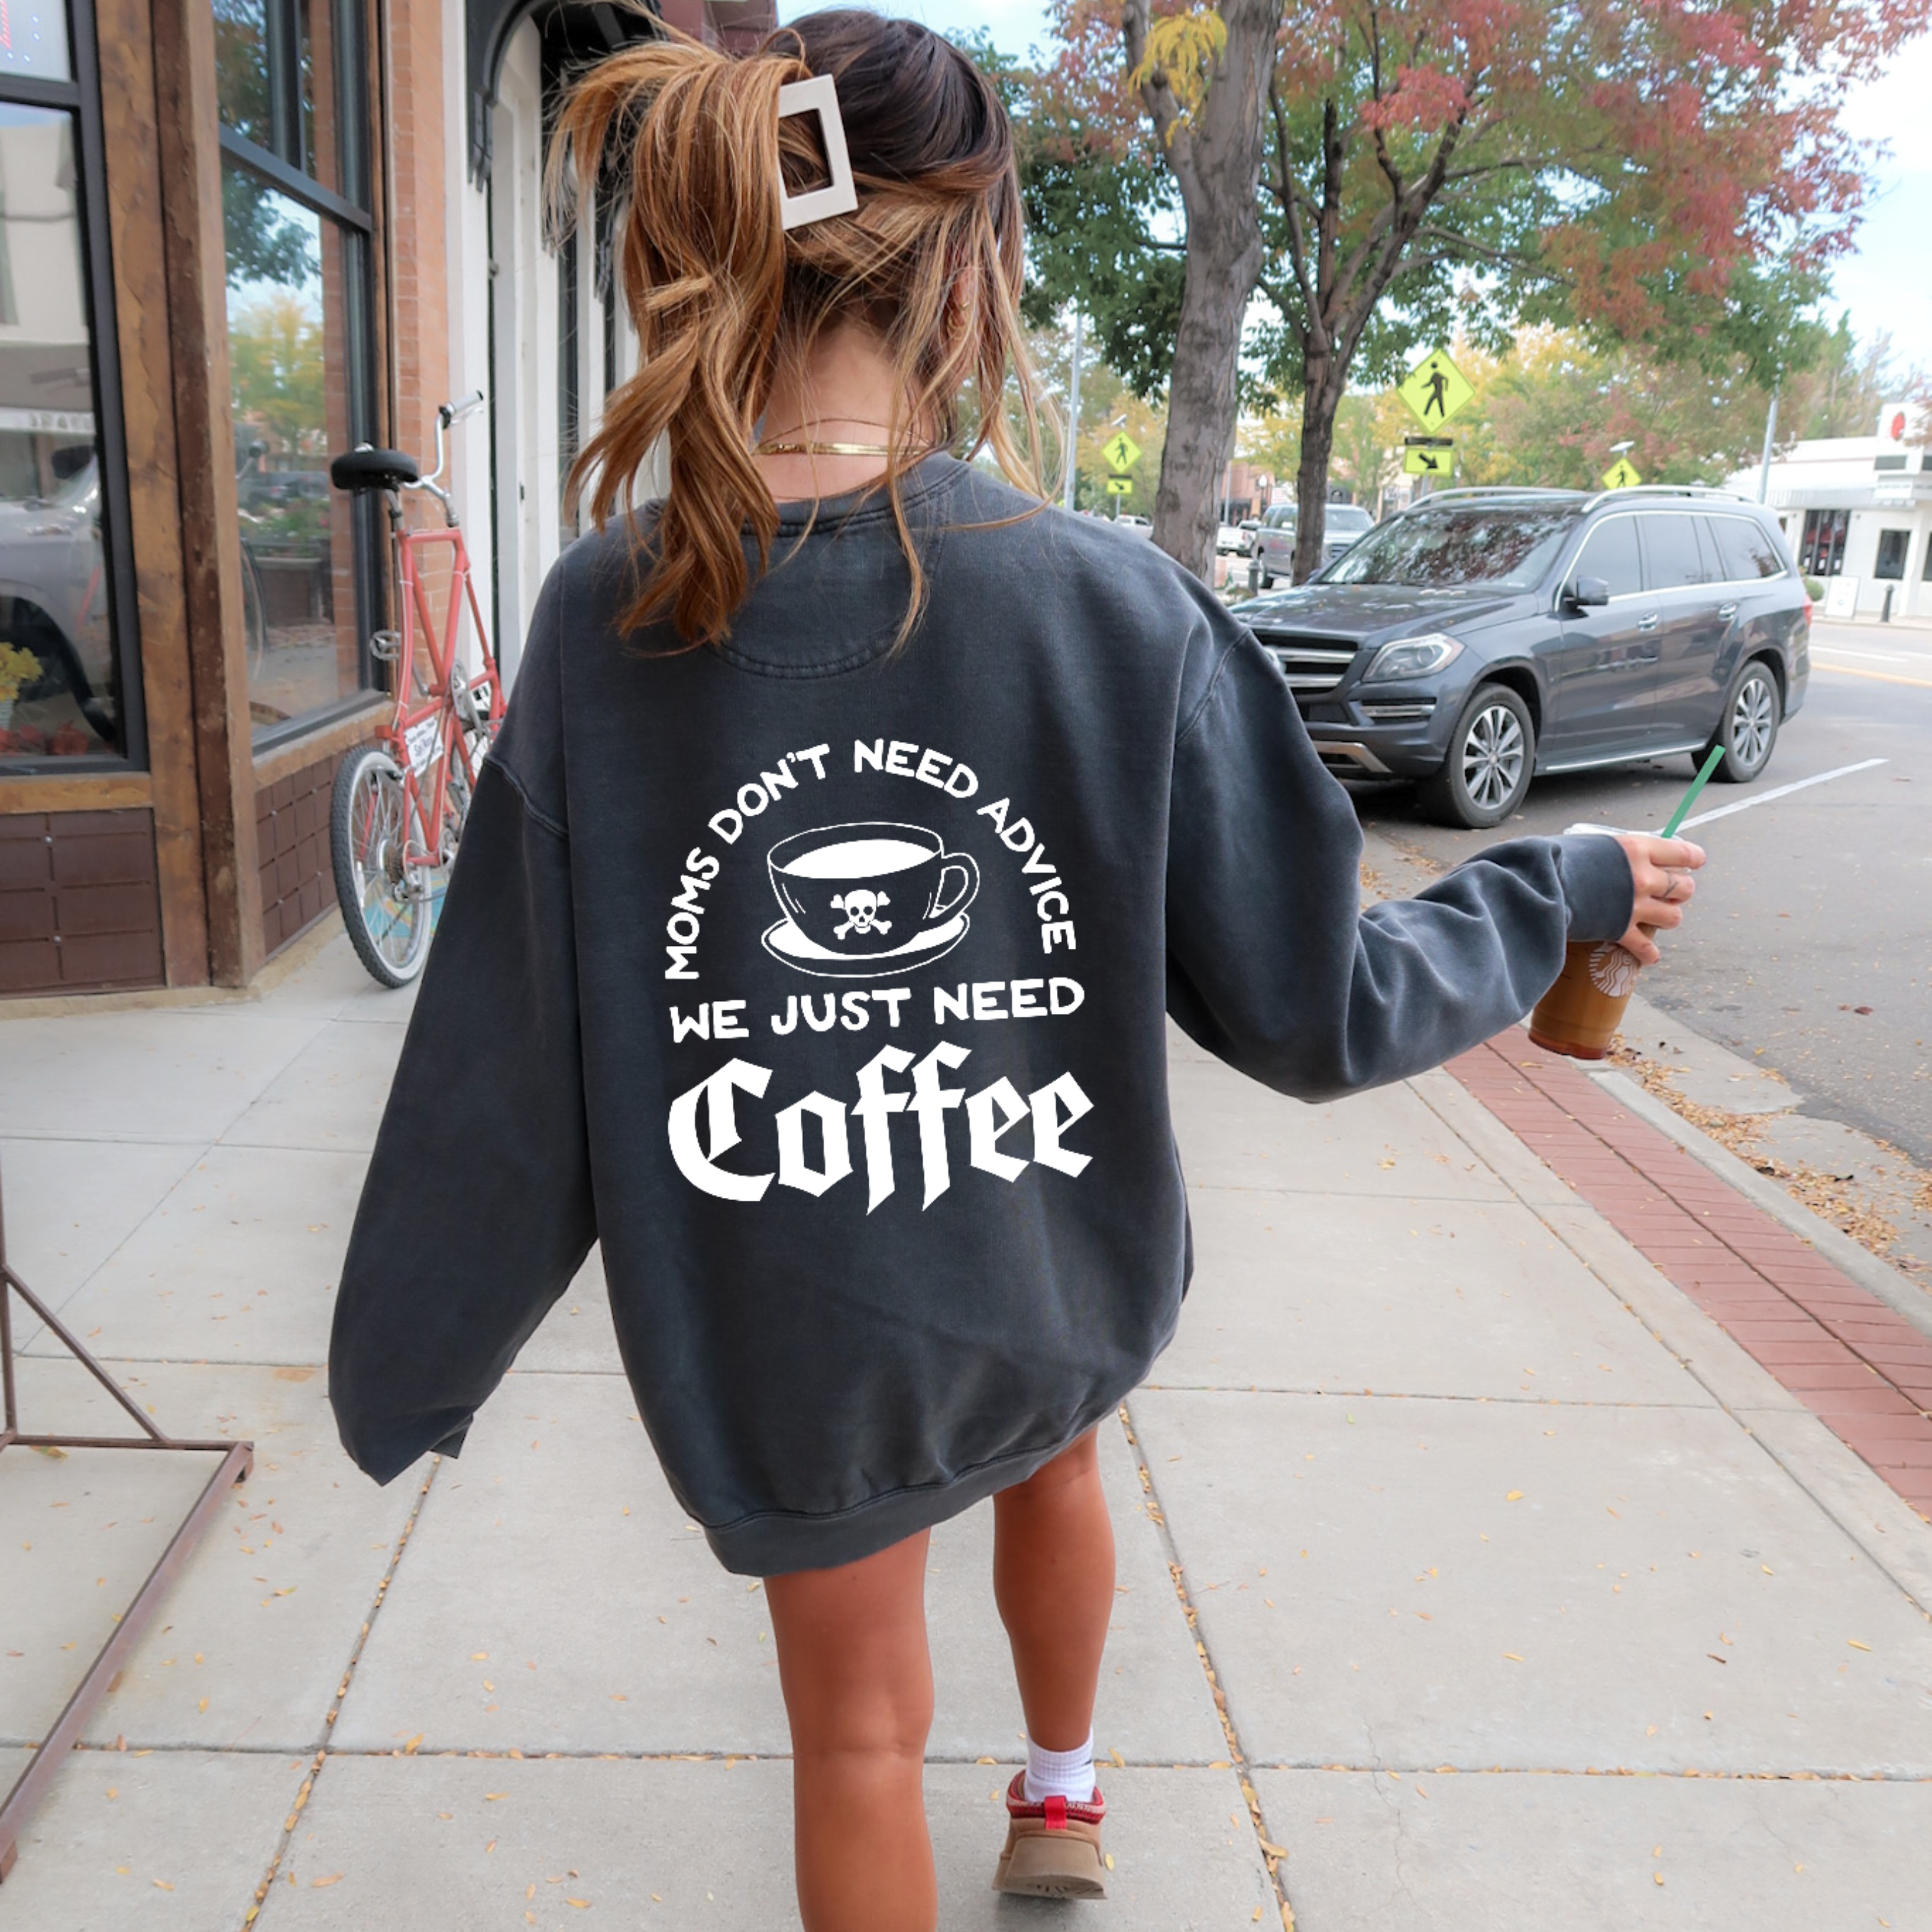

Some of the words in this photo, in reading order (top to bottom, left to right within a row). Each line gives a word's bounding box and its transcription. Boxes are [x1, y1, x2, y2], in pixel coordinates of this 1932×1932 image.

[665, 847, 719, 979] MOMS
[708, 744, 830, 844] DON'T
[854, 738, 978, 798] NEED
[977, 798, 1076, 953] ADVICE
[670, 1000, 749, 1043] WE
[771, 987, 912, 1035] JUST
[934, 977, 1084, 1024] NEED
[668, 1041, 1094, 1215] Coffee
